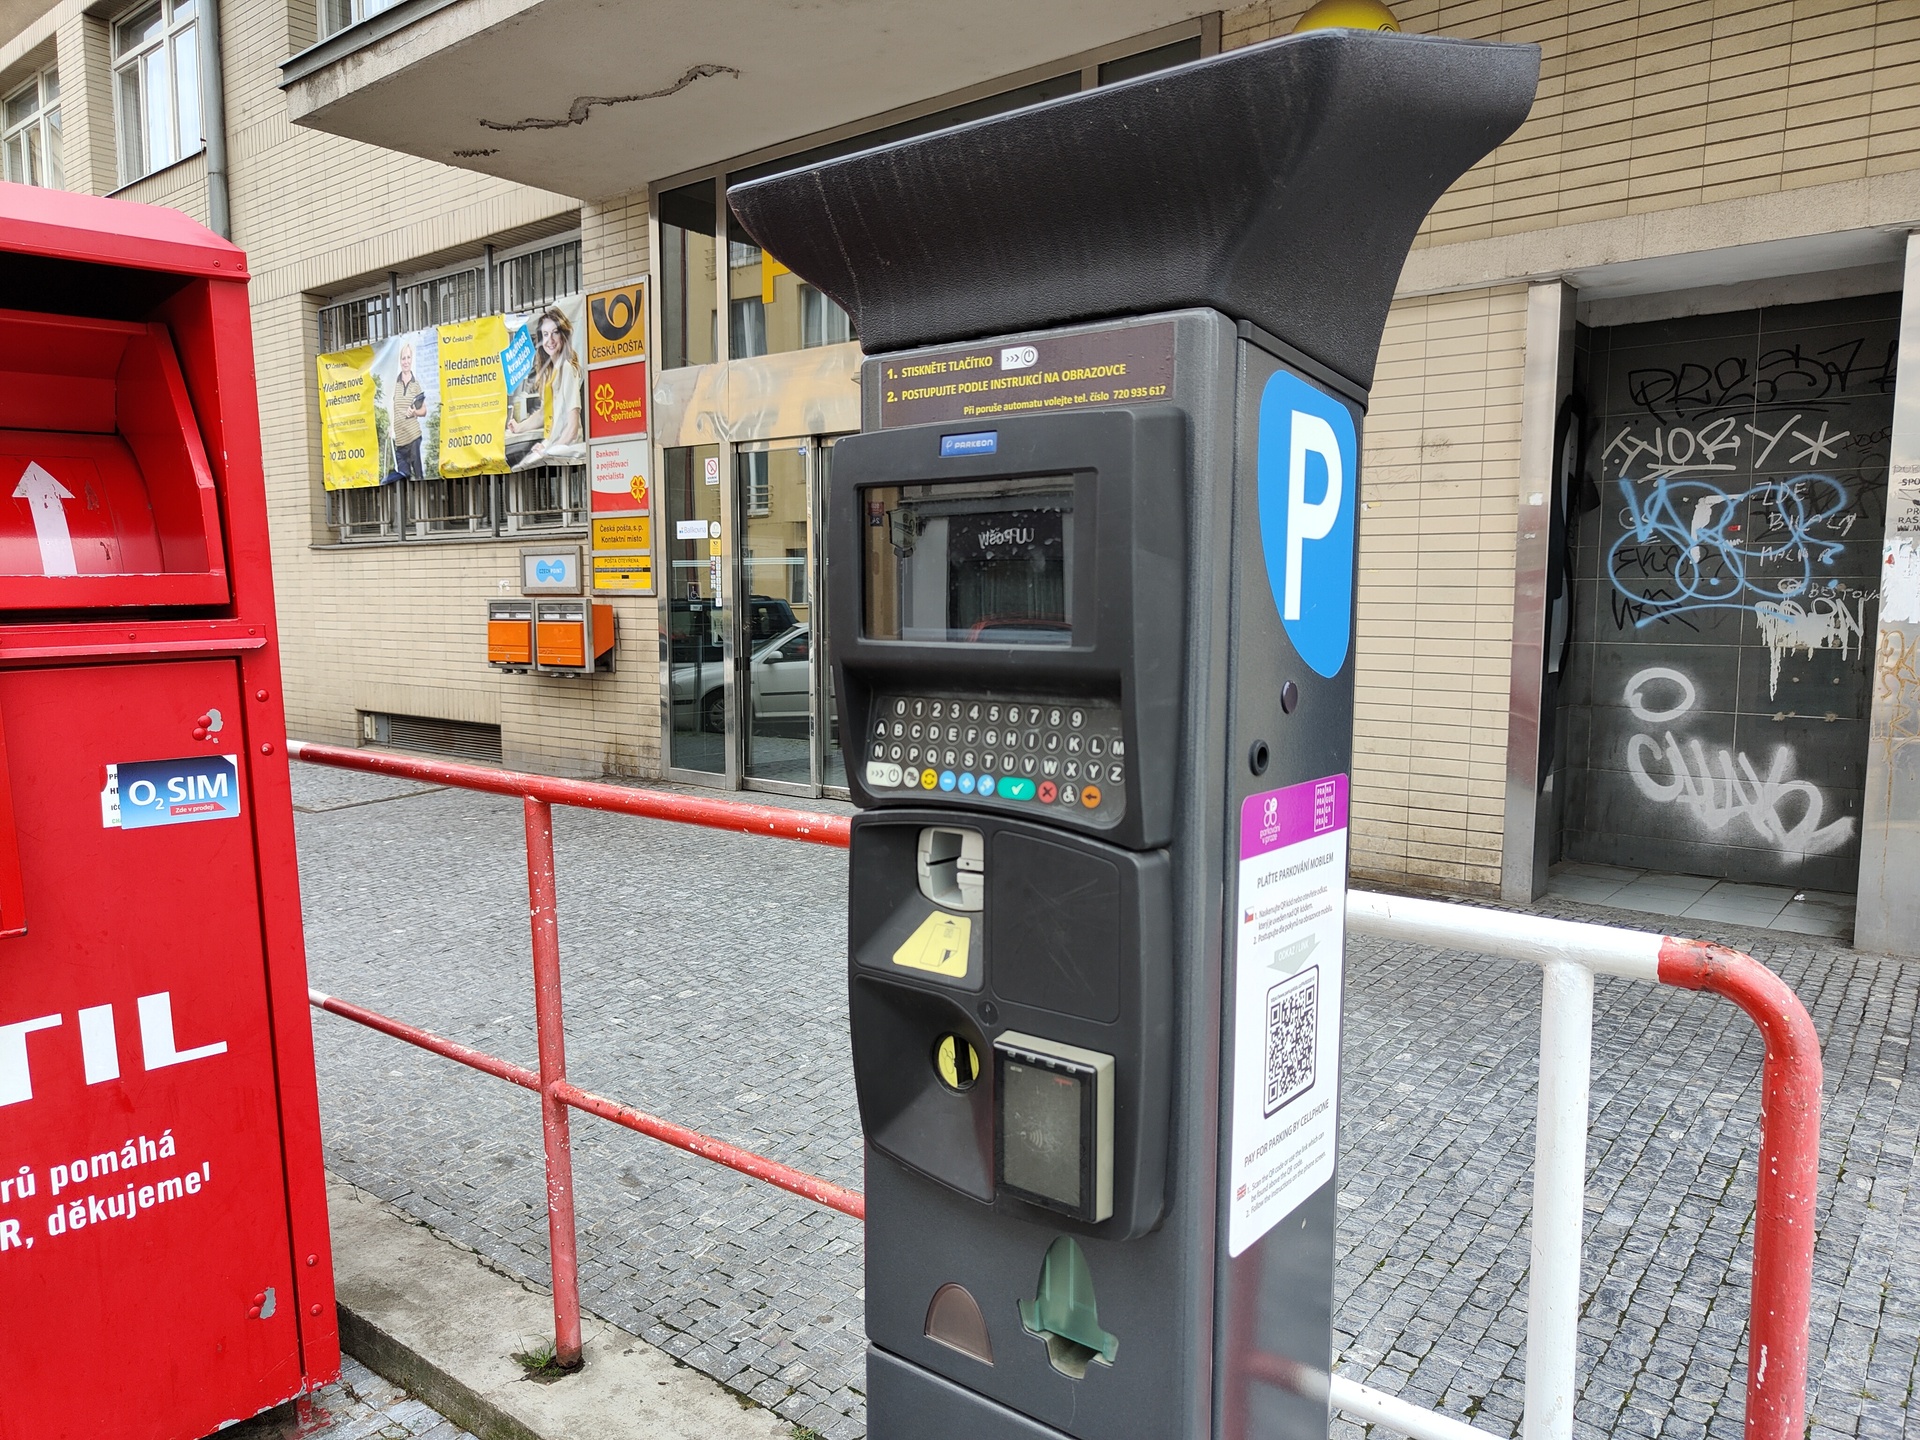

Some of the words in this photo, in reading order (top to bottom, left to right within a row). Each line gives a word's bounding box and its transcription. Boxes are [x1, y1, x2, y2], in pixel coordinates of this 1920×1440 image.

[480, 351, 500, 366] nové
[591, 343, 616, 359] ČESKÁ
[617, 339, 644, 354] POŠTA
[886, 368, 898, 379] 1.
[901, 361, 947, 378] STISKNĚTE
[948, 356, 993, 372] TLAČÍTKO
[446, 371, 497, 387] aměstnance
[887, 391, 898, 403] 2.
[902, 384, 957, 401] POSTUPUJTE
[958, 380, 989, 394] PODLE
[990, 371, 1042, 390] INSTRUKCÍ
[1044, 372, 1060, 384] NA
[1061, 363, 1127, 382] OBRAZOVCE
[615, 397, 641, 411] Poštovní
[963, 405, 975, 416] Při
[975, 402, 1003, 416] poruše
[1003, 398, 1042, 412] automatu
[1044, 396, 1073, 407] volejte
[1074, 393, 1088, 403] tel.
[1089, 391, 1110, 402] číslo
[1113, 389, 1130, 399] 720
[1131, 387, 1147, 398] 935
[1149, 386, 1166, 396] 617
[611, 409, 642, 423] spořitelna
[474, 433, 492, 444] 000
[954, 439, 994, 449] PARKEON
[348, 448, 365, 458] 000
[595, 449, 620, 458] Bankovní
[600, 459, 629, 471] pojišťovací
[596, 472, 625, 482] specialista
[1284, 409, 1343, 620] P
[600, 524, 615, 532] Česká
[616, 524, 632, 533] pošta,
[601, 535, 626, 543] Kontaktní
[897, 701, 905, 714] 0
[915, 702, 922, 715] 1
[933, 703, 941, 717] 2
[951, 704, 959, 718] 3
[969, 705, 978, 719] 4
[990, 707, 998, 720] 5
[1009, 708, 1018, 722] 6
[1031, 709, 1039, 723] 7
[1050, 710, 1060, 725] 8
[1072, 712, 1081, 726] 9
[877, 723, 885, 734] A
[894, 724, 903, 737] B
[912, 725, 920, 737] C
[930, 727, 939, 738] D
[949, 728, 957, 740] E
[968, 730, 976, 742] F
[986, 731, 996, 743] G
[1007, 733, 1016, 745] H
[1029, 735, 1034, 747] I
[1048, 736, 1057, 749] J
[1069, 738, 1079, 751] K
[1092, 739, 1100, 752] L
[1113, 742, 1124, 754] M
[874, 746, 883, 757] N
[892, 747, 900, 758] O
[910, 748, 918, 760] P
[927, 749, 937, 762] Q
[946, 752, 955, 763] R
[965, 754, 973, 766] S
[985, 755, 993, 767] T
[1004, 757, 1013, 769] U
[1025, 759, 1034, 772] V
[1044, 761, 1057, 774] W
[1066, 763, 1077, 776] X
[1089, 765, 1099, 777] Y
[1111, 767, 1121, 780] Z
[167, 773, 229, 802] SIM
[192, 804, 215, 814] prodeji
[1257, 871, 1277, 887] PLAŤTE
[1279, 859, 1309, 879] PARKOVÁNÍ
[1310, 852, 1333, 868] MOBILEM
[1278, 946, 1294, 960] ODKAZ
[1298, 939, 1308, 951] LINK
[0, 991, 228, 1107] TIL
[1244, 1151, 1255, 1166] PAY
[1256, 1142, 1267, 1158] FOR
[1268, 1125, 1292, 1149] PARKING
[1292, 1119, 1299, 1132] BY
[1300, 1099, 1328, 1126] CELLPHONE
[0, 1165, 36, 1203] rů
[50, 1129, 176, 1196] pomáhá
[0, 1218, 34, 1250] R,
[48, 1161, 210, 1236] děkujeme!
